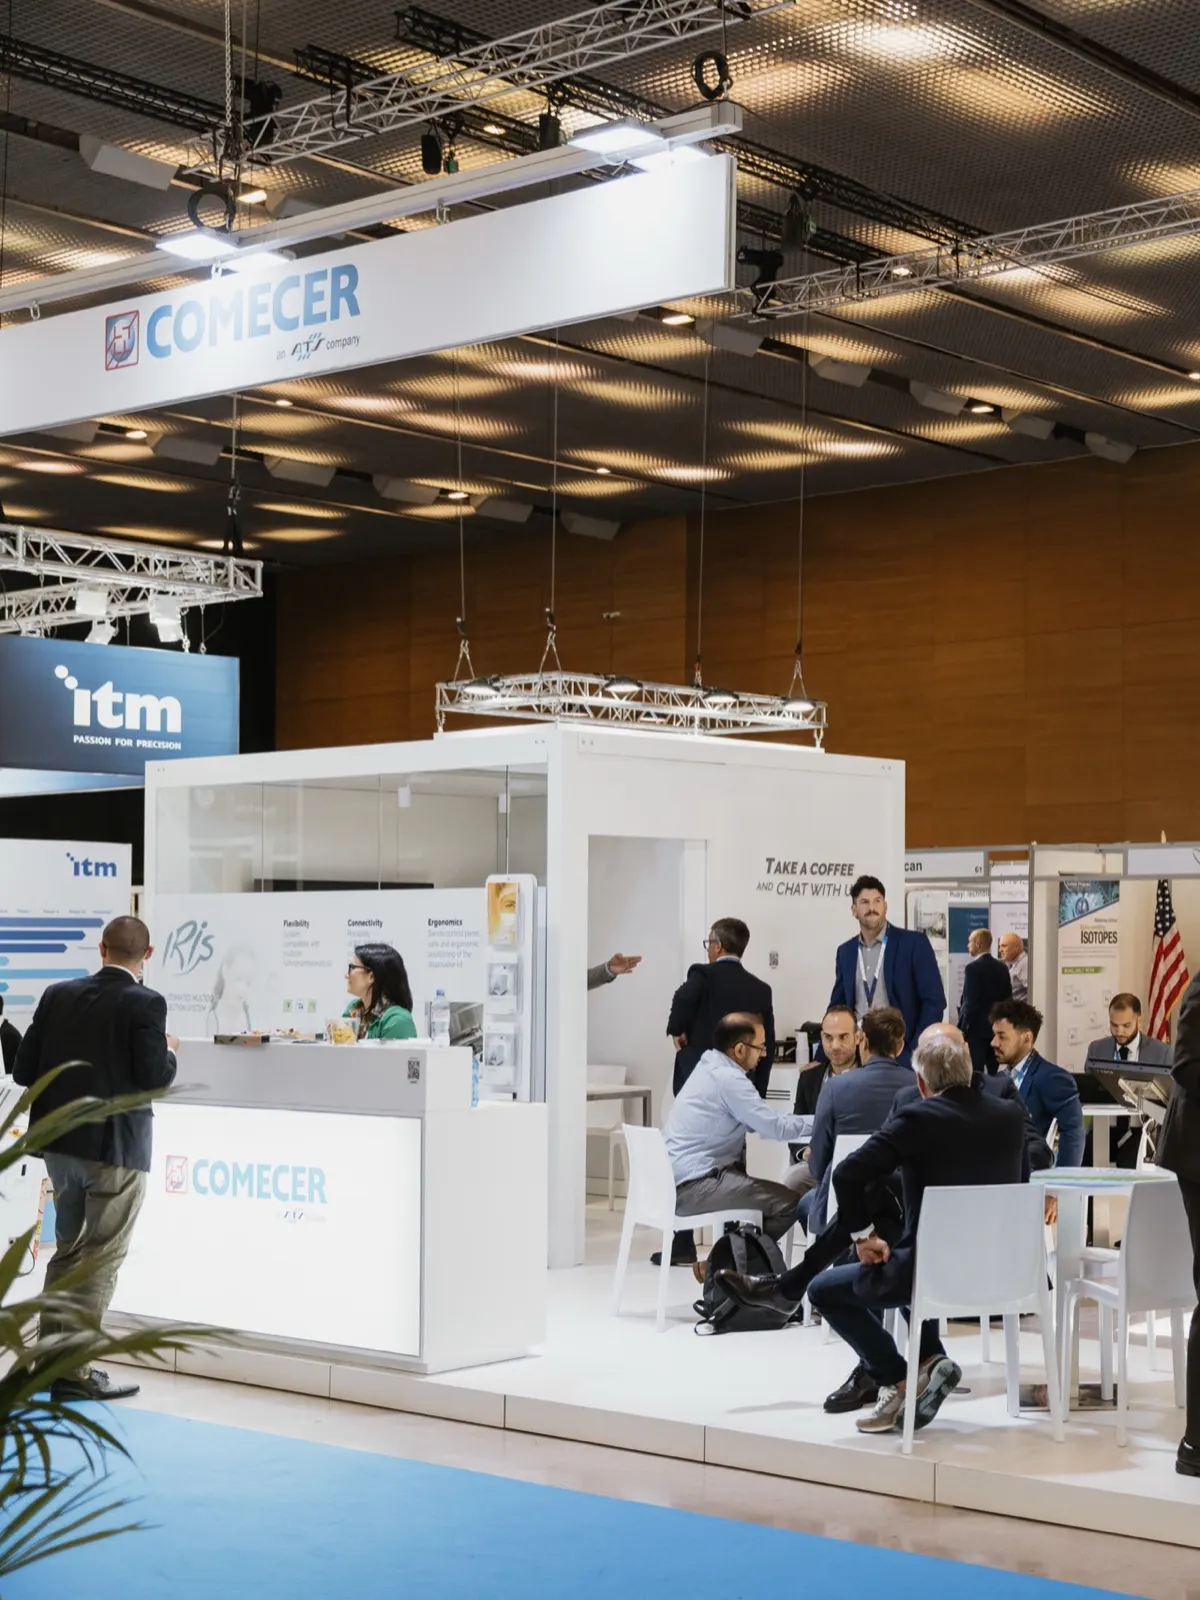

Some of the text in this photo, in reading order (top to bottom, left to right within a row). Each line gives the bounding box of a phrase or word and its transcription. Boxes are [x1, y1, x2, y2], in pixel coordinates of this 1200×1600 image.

[146, 263, 361, 359] COMECER
[276, 350, 286, 360] an
[325, 335, 361, 351] company
[64, 672, 182, 733] itm
[73, 735, 182, 750] PASSION FOR PRECISION
[69, 855, 117, 877] itm
[766, 857, 855, 877] TAKE A COFFEE
[756, 882, 773, 891] AND
[776, 882, 809, 896] CHAT
[811, 883, 841, 897] WITH
[283, 919, 310, 929] Flexibility
[347, 919, 383, 929] Connectivity
[427, 918, 463, 928] Ergonomics
[1081, 931, 1118, 944] ISOTOPES
[192, 1159, 328, 1204] COMECER
